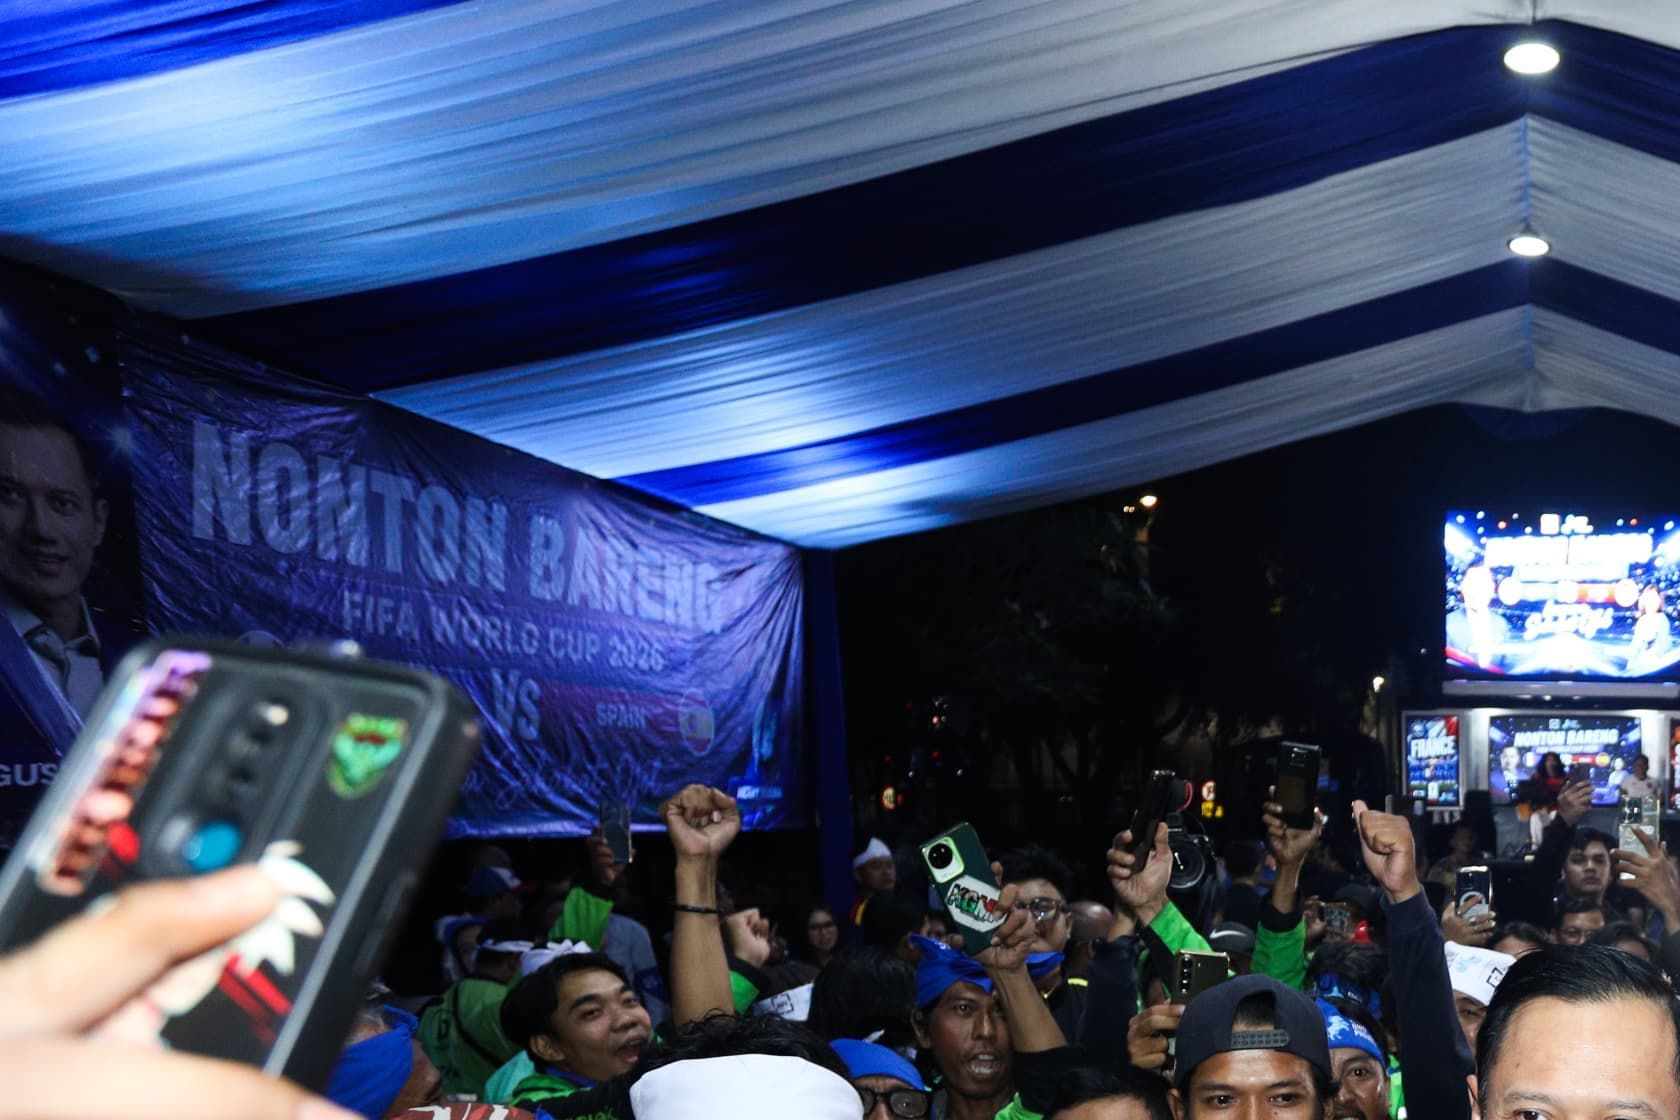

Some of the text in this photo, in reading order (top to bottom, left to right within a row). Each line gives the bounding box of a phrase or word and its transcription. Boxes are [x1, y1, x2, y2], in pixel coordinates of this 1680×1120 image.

[193, 420, 507, 593] NONTON
[343, 590, 665, 673] FIFA WORLD CUP 2026
[491, 667, 541, 740] VS
[596, 703, 646, 730] SPAIN
